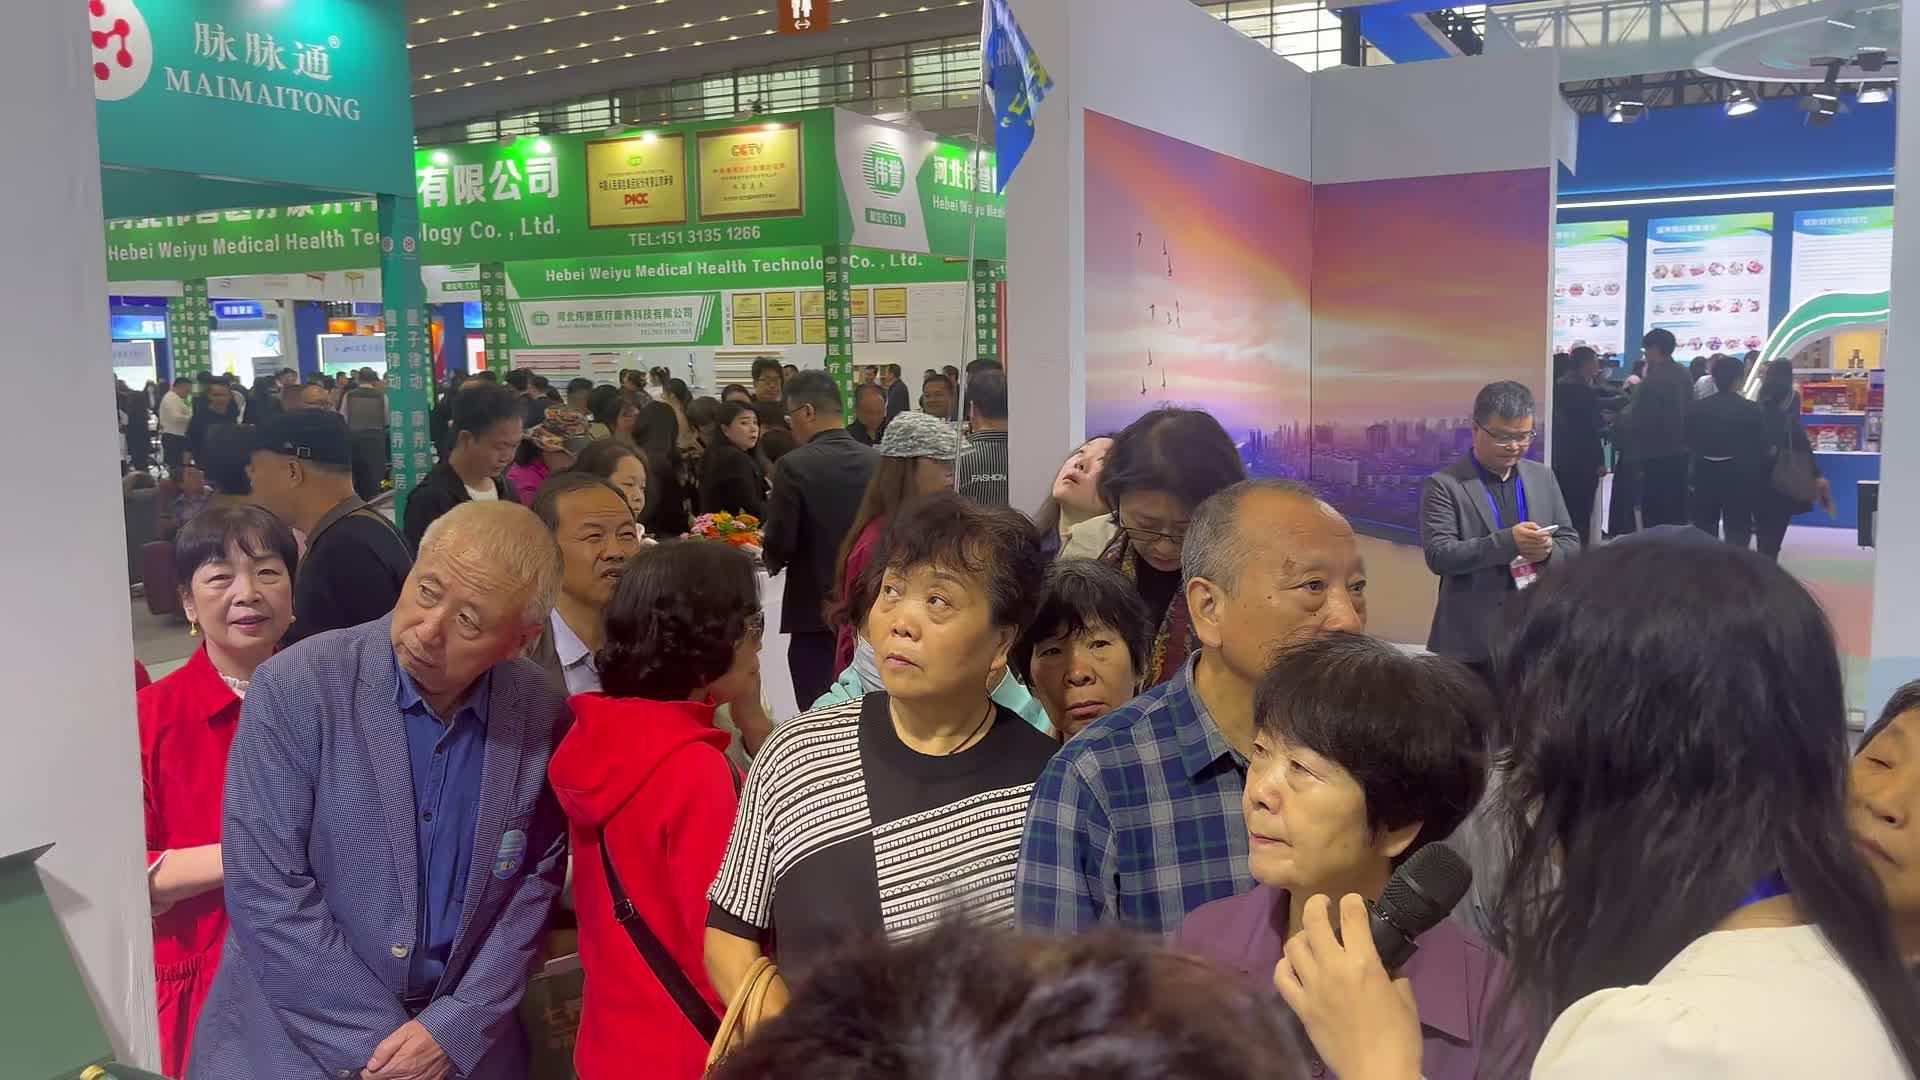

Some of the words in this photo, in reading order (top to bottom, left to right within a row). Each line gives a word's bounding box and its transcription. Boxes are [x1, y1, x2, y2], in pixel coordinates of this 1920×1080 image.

[194, 22, 332, 81] 脉脉通
[164, 67, 361, 121] MAIMAITONG
[415, 157, 560, 209] 有限公司
[108, 243, 153, 261] Hebei
[159, 241, 208, 262] Weiyu
[212, 234, 280, 256] Medical
[286, 229, 345, 251] Health
[521, 214, 561, 236] Ltd.
[687, 228, 721, 244] 3135
[726, 225, 761, 241] 1266
[546, 268, 586, 282] Hebei
[590, 266, 631, 282] Weiyu
[635, 261, 693, 278] Medical
[697, 259, 747, 275] Health
[890, 252, 924, 267] Ltd.
[971, 474, 1007, 483] FASHION
